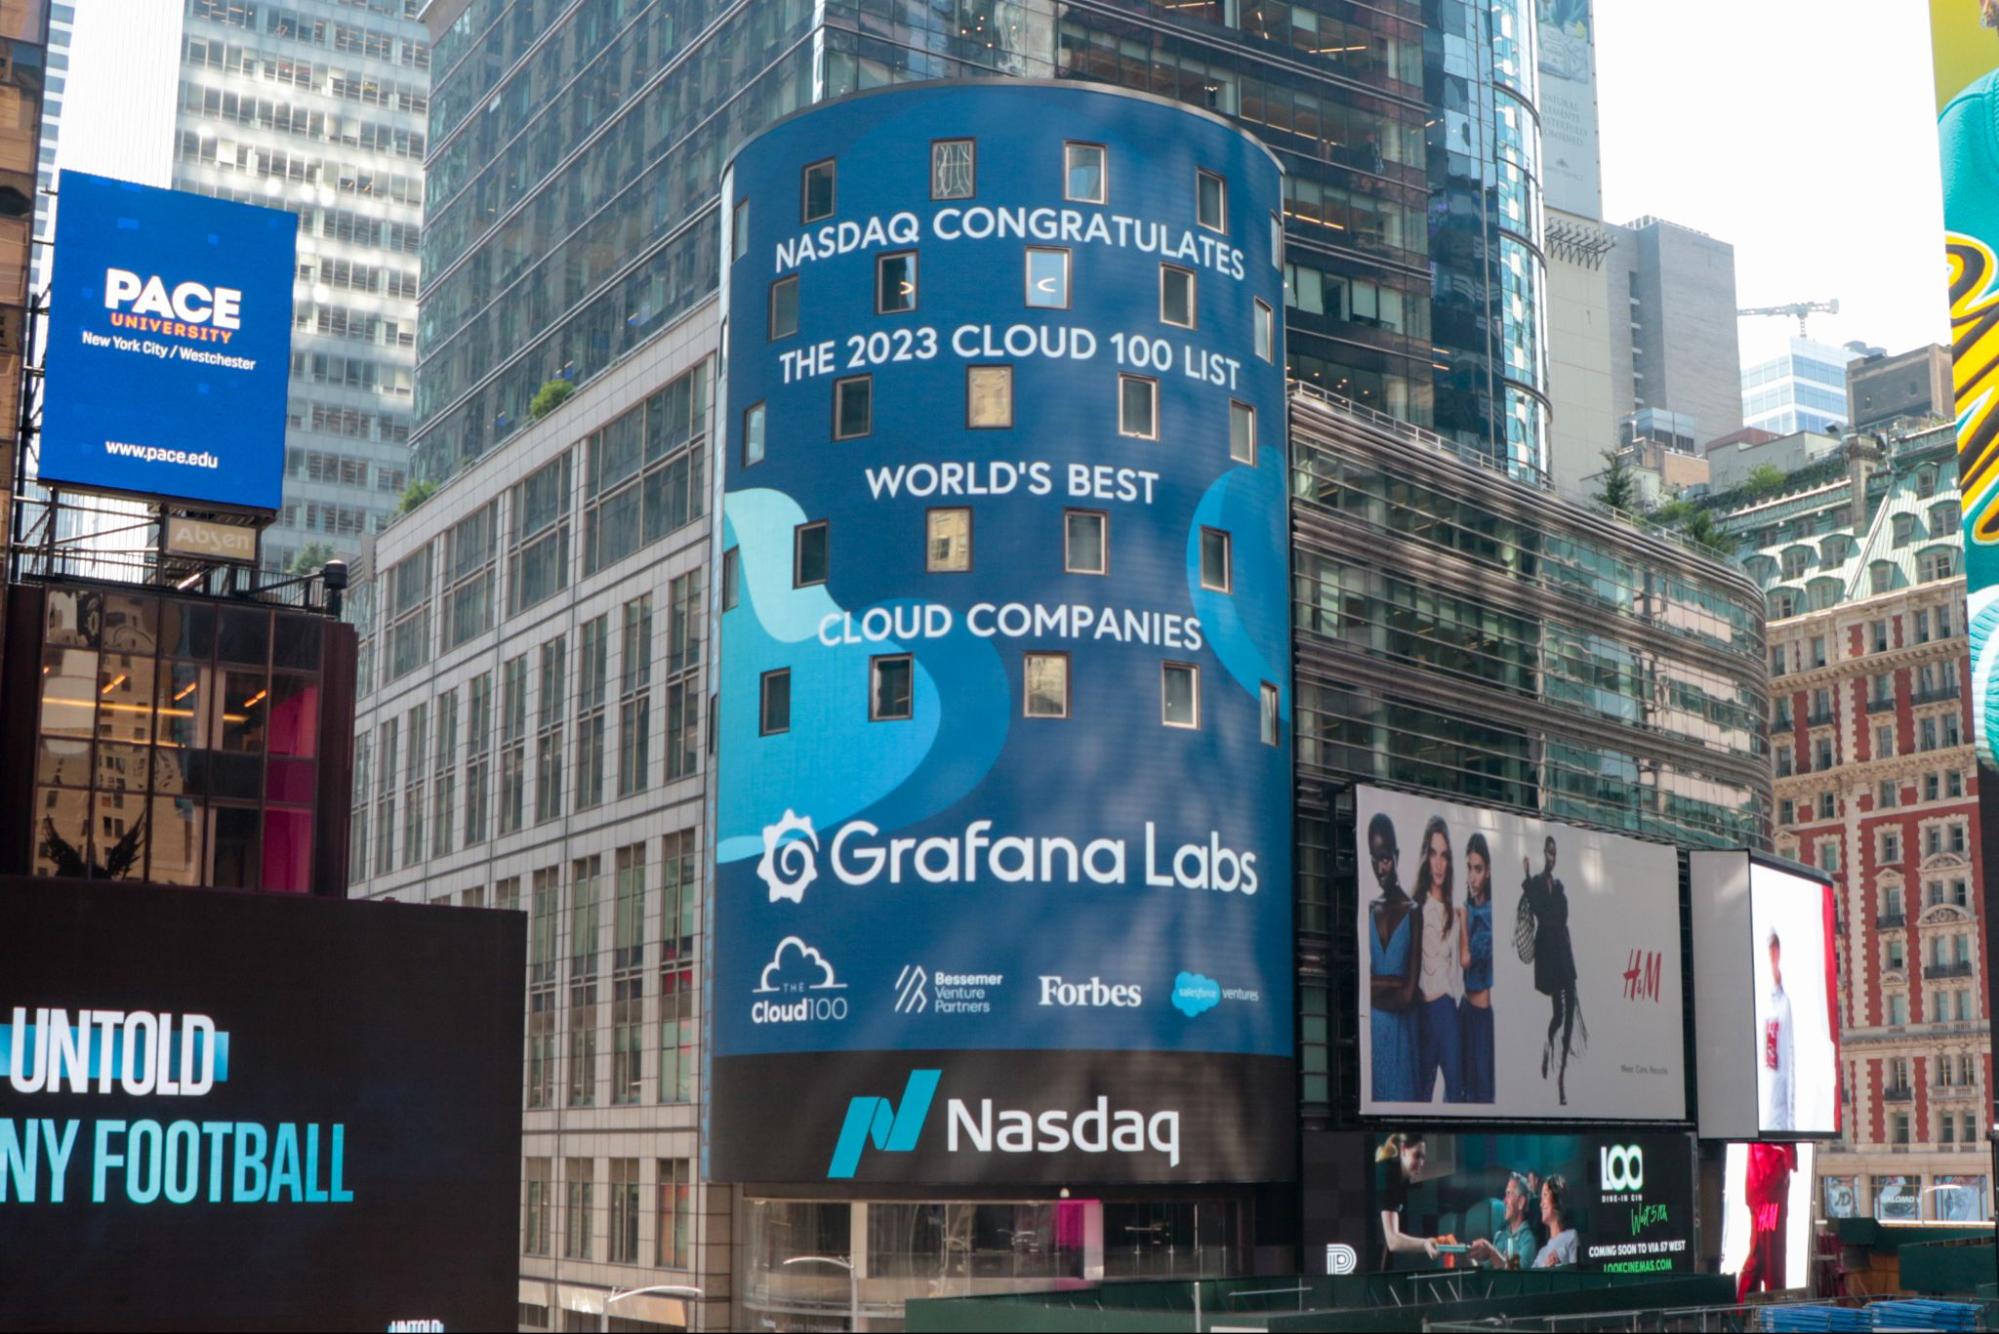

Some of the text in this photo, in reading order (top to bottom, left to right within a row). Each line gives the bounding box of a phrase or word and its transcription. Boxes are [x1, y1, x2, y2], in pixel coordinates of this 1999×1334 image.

[776, 206, 1245, 281] NASDAQ CONGRATULATES
[104, 267, 242, 330] PACE
[110, 312, 233, 344] UNIVERSITY
[82, 331, 112, 347] New
[113, 335, 141, 352] York
[142, 340, 169, 359] City
[179, 347, 256, 370] Westchester
[780, 325, 1240, 390] THE 2023 CLOUD 100 LIST
[105, 441, 219, 470] www.pace.edu
[865, 461, 1159, 504] WORLD'S BEST
[175, 526, 250, 552] Absen
[818, 602, 1202, 651] CLOUD COMPANIES
[830, 820, 1258, 895] Grafana Labs
[783, 982, 805, 993] THE
[934, 971, 1003, 986] Bessemer
[934, 985, 986, 999] Venture
[1038, 975, 1142, 1007] Forbes
[1622, 948, 1662, 1003] H&M
[751, 997, 848, 1024] Cloud100
[934, 999, 991, 1013] Partners
[1222, 987, 1259, 1002] ventures
[10, 1006, 216, 1096] UNTOLD
[947, 1095, 1180, 1167] Nasdaq
[0, 1118, 355, 1204] NY FOOTBALL
[1588, 1244, 1617, 1258] COMING
[1617, 1243, 1638, 1256] SOON
[1638, 1242, 1648, 1254] TO
[1648, 1241, 1659, 1253] VIA
[1669, 1239, 1686, 1252] WEST
